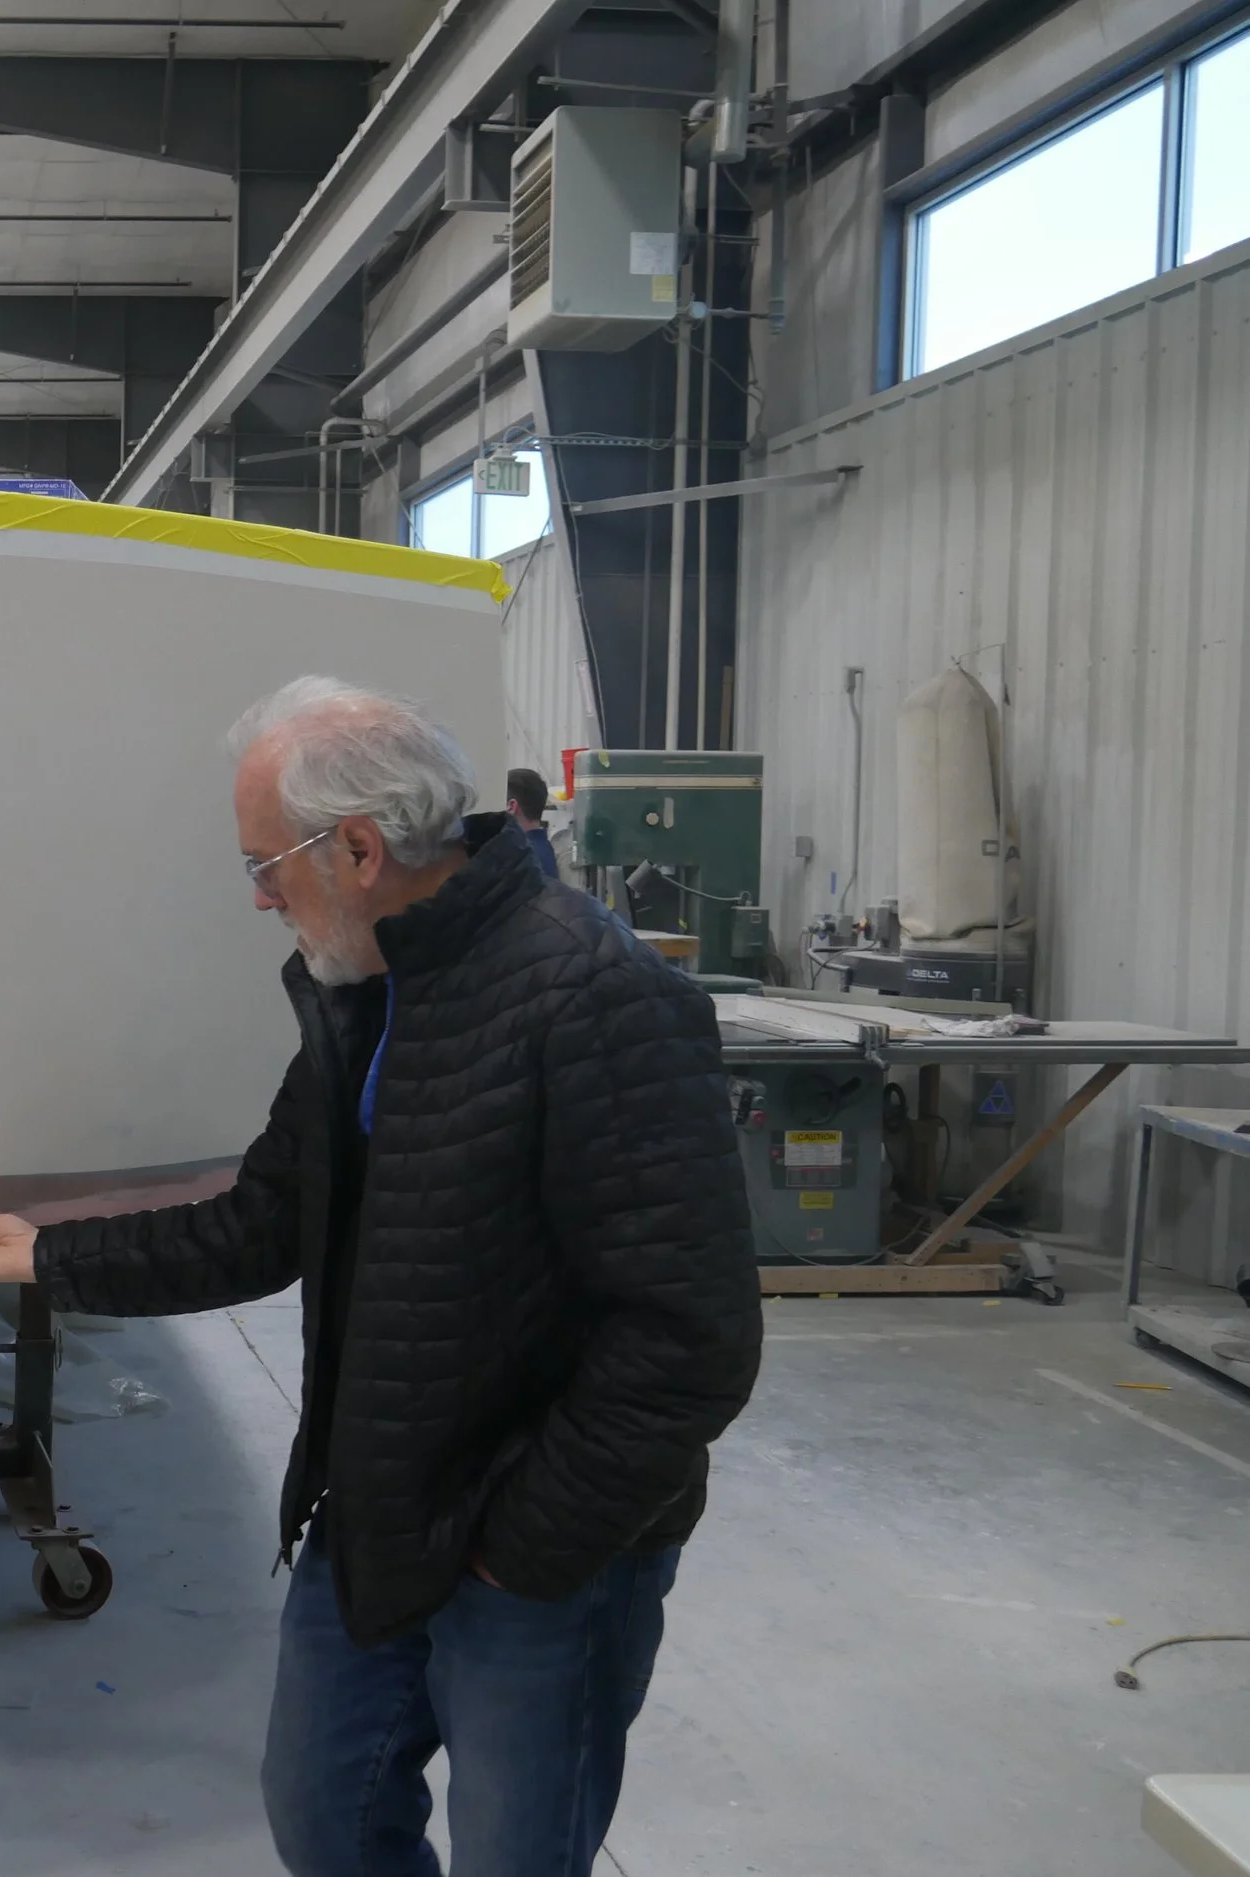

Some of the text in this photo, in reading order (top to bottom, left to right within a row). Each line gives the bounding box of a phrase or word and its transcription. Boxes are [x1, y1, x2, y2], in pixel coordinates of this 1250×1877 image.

[486, 462, 522, 491] EXIT
[912, 968, 949, 979] DELTA
[797, 1133, 837, 1141] CAUTION
